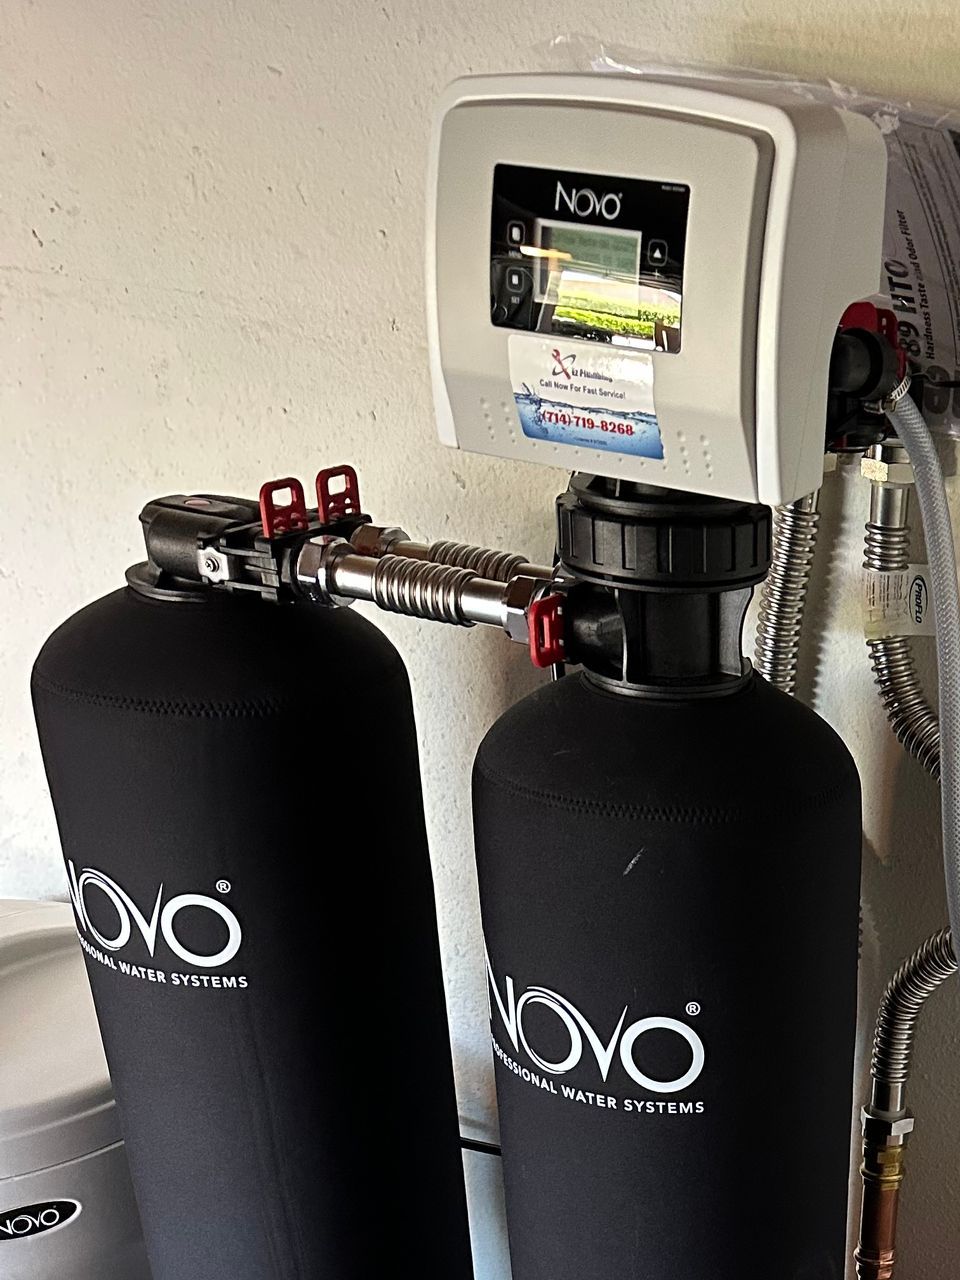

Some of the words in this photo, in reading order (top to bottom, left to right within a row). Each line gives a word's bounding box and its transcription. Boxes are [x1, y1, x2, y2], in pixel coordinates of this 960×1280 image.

[896, 208, 913, 237] Filter
[905, 235, 919, 262] Odor
[917, 283, 930, 311] Taste
[922, 311, 936, 360] Hardness
[539, 379, 553, 388] Call
[553, 381, 569, 391] Now
[570, 383, 582, 393] For
[582, 386, 598, 396] Fast
[599, 388, 627, 400] Service!
[573, 415, 634, 437] 719-8268
[118, 961, 167, 985] WATER
[171, 972, 249, 989] SYSTEMS
[561, 1085, 618, 1110] WATER
[623, 1099, 705, 1115] SYSTEMS
